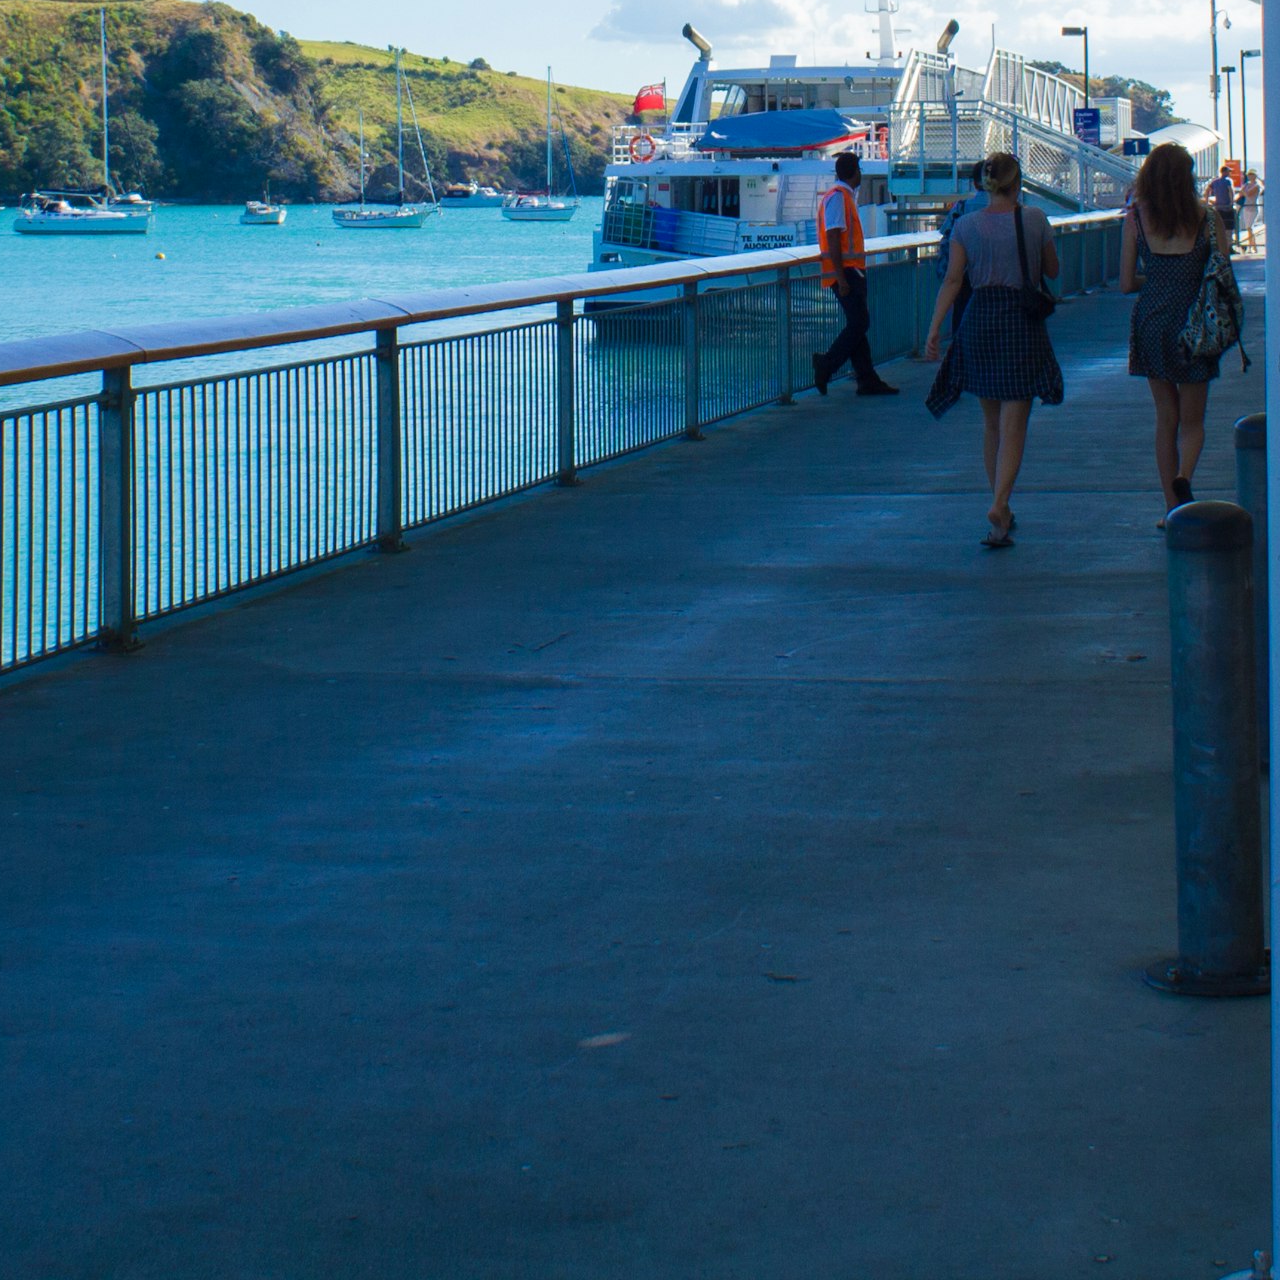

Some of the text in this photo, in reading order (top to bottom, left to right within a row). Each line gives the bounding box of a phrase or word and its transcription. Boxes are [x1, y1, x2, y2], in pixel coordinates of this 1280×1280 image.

[1132, 140, 1139, 154] 1
[741, 234, 794, 243] TE KOTUKU
[744, 242, 792, 250] AUCKLAND
